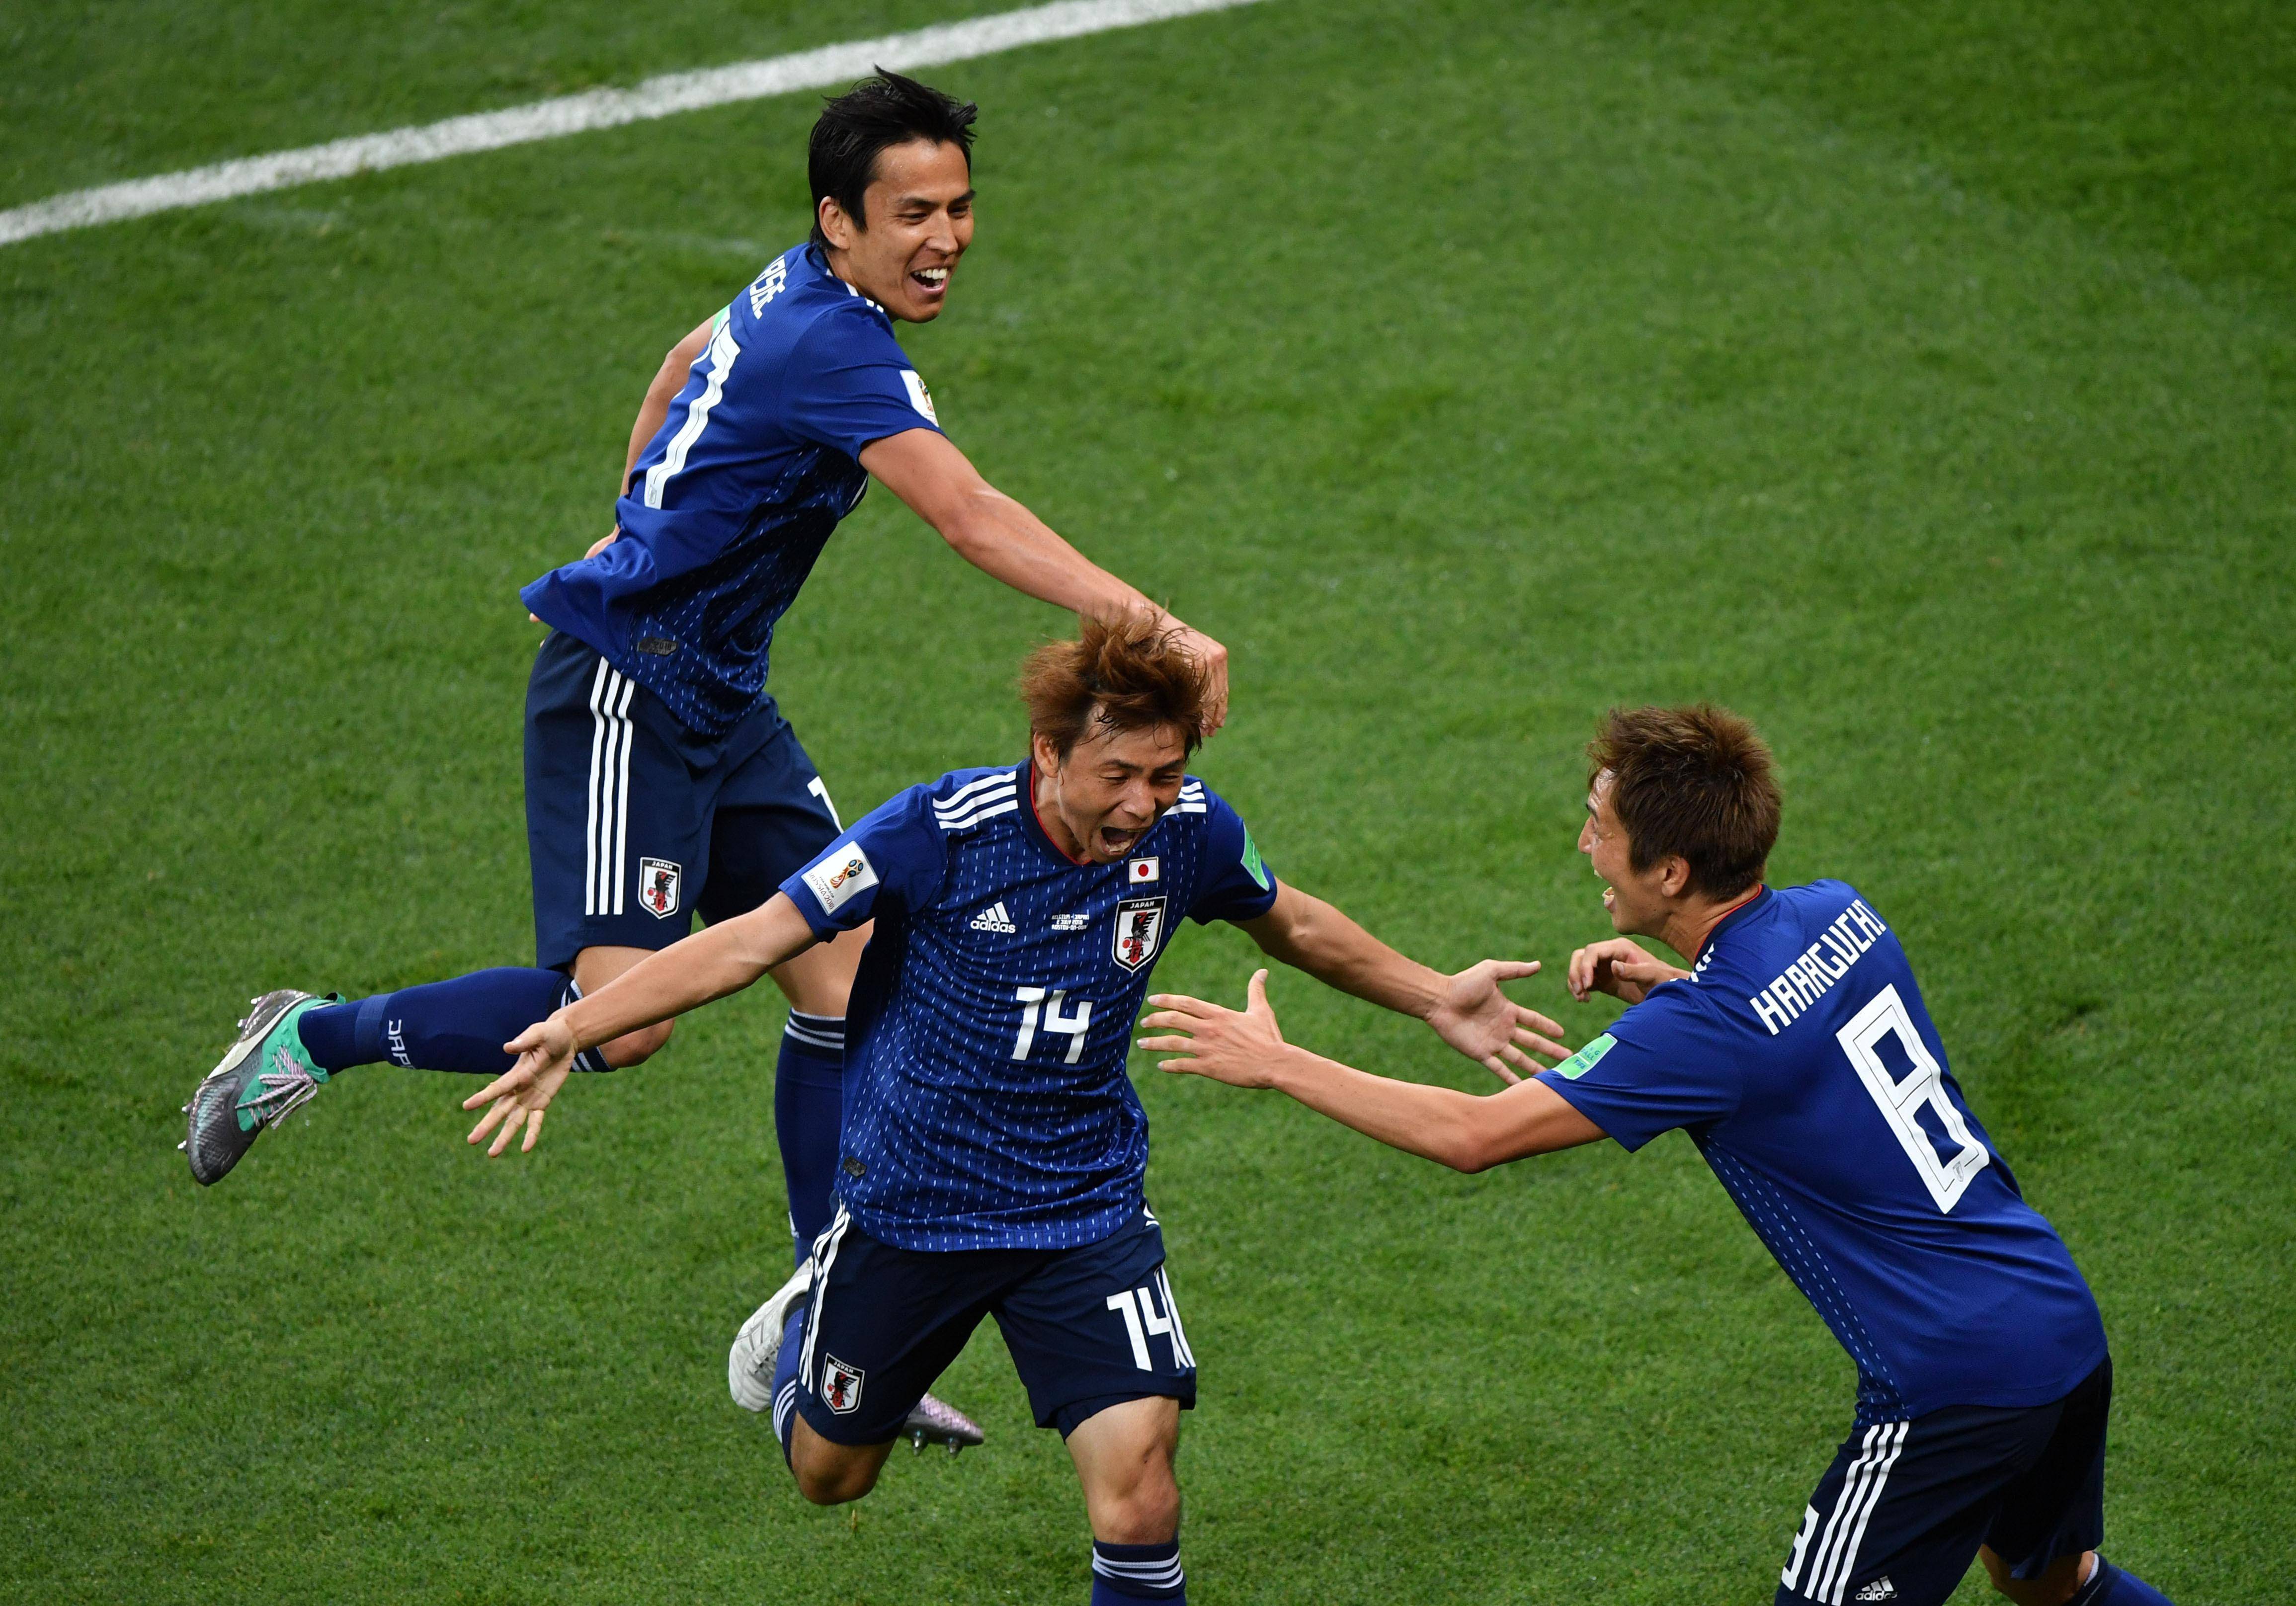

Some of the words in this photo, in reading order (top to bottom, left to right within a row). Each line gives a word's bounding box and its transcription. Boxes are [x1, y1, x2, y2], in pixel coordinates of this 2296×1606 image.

[652, 861, 673, 870] JAPAN
[809, 873, 827, 897] RUSSIA
[823, 894, 835, 910] 2018
[1130, 900, 1155, 909] JAPAN
[970, 919, 1016, 934] adidas
[1749, 899, 1886, 1036] HARAGUCHI
[1012, 986, 1093, 1064] 14
[1836, 983, 1989, 1214] 8
[1107, 1287, 1180, 1371] 14
[833, 1361, 854, 1374] JAPAN
